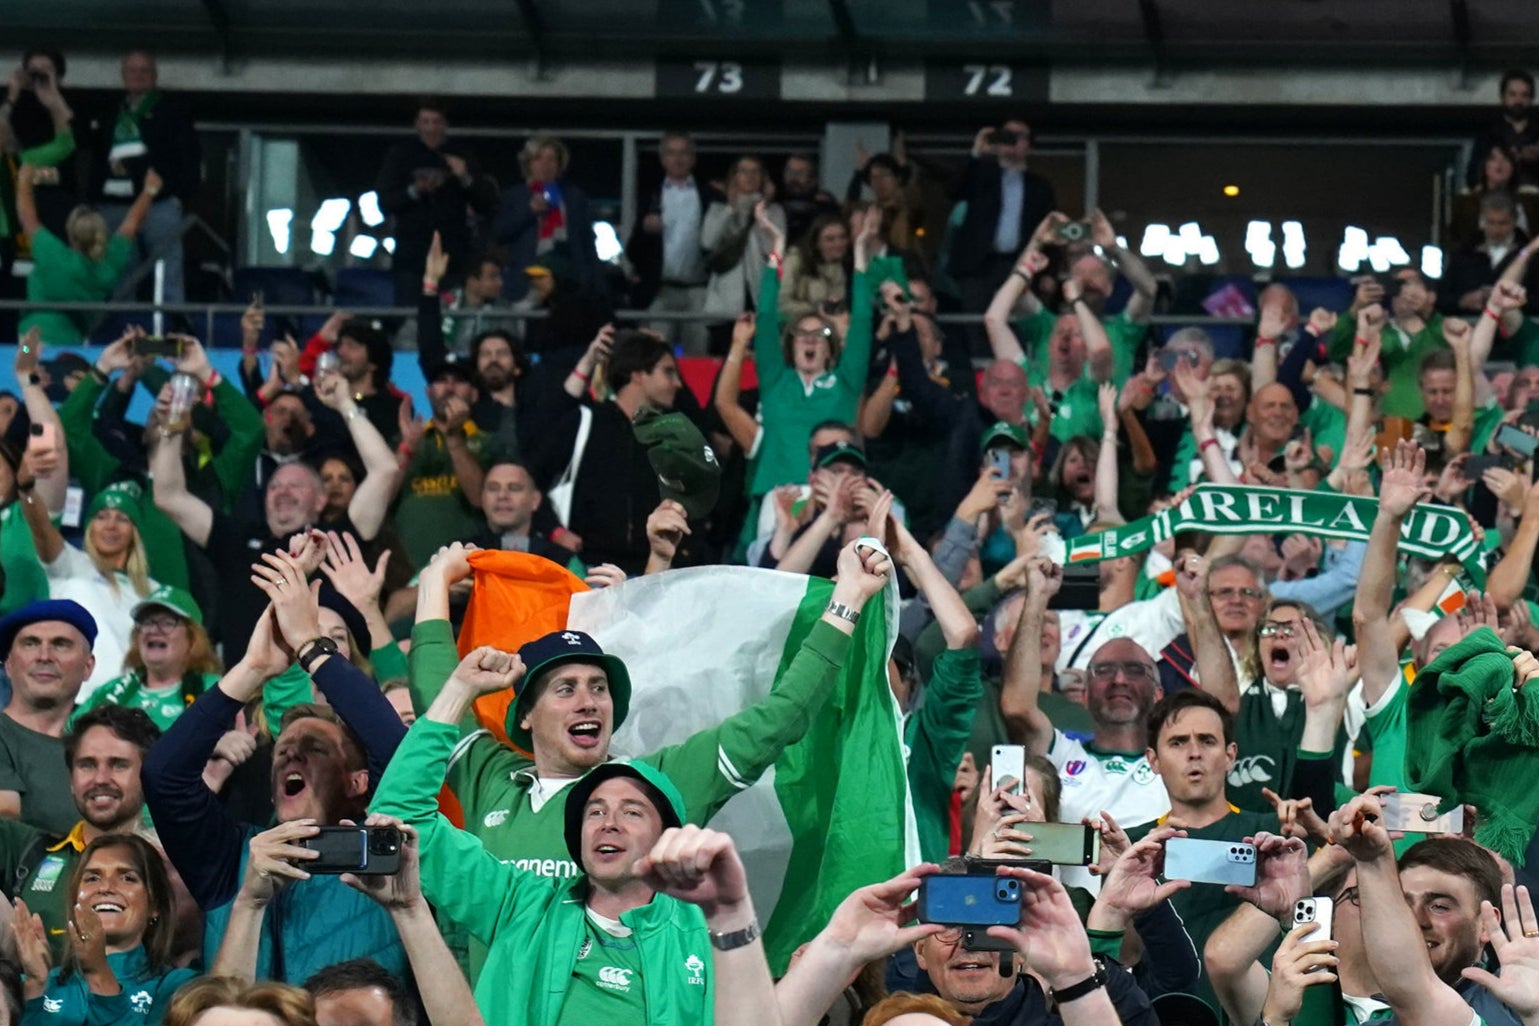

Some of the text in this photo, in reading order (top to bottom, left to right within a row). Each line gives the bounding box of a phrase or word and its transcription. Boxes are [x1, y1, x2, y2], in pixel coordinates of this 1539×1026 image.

[694, 62, 743, 94] 73
[964, 65, 1013, 97] 72
[596, 980, 630, 993] canterbury
